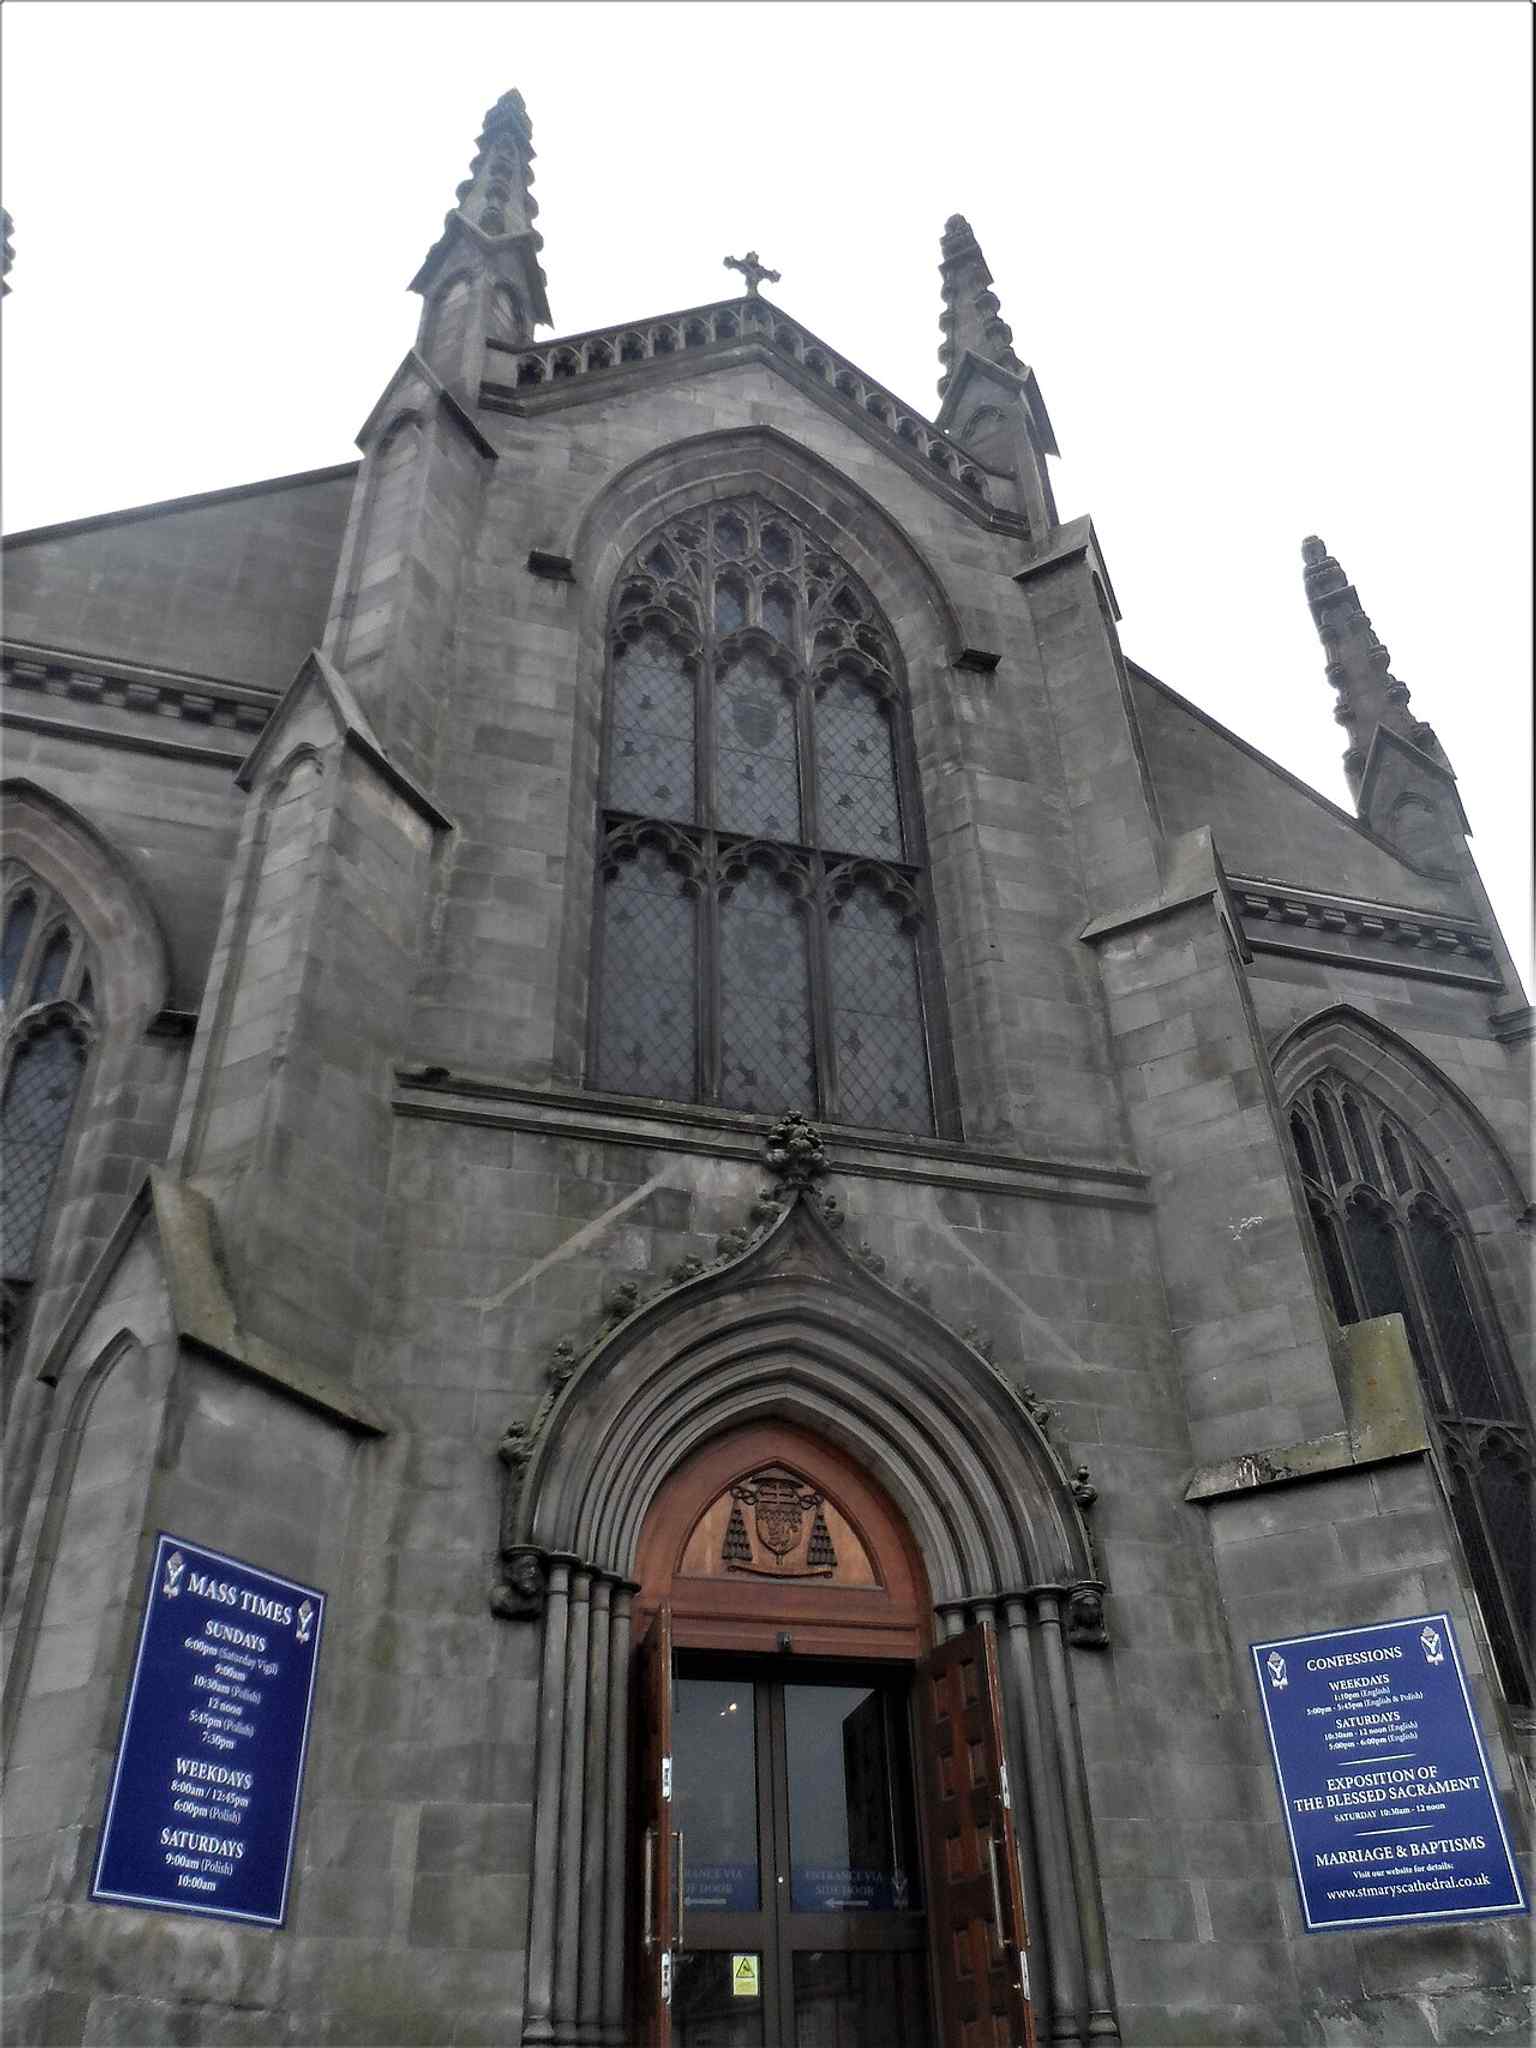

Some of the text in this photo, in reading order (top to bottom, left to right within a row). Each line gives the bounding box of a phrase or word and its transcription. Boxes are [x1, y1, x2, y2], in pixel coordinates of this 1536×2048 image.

[187, 1573, 292, 1625] MASS TIMES
[184, 1637, 217, 1656] 6:00pm
[205, 1620, 265, 1652] SUNDAYS
[1306, 1646, 1402, 1671] CONFESSIONS
[193, 1674, 230, 1694] 10:30am
[1328, 1673, 1390, 1691] WEEKDAYS
[208, 1697, 243, 1716] 12 noon
[189, 1710, 222, 1728] 5:45pm
[1335, 1711, 1401, 1729] SATURDAYS
[202, 1731, 235, 1750] 7:30pm
[176, 1757, 253, 1790] WEEKDAYS
[1327, 1765, 1438, 1791] EXPOSITION OF
[171, 1779, 204, 1797] 8:00am
[212, 1788, 249, 1808] 12:45pm
[1293, 1776, 1480, 1812] THE BLESSED SACRAMENT
[174, 1799, 241, 1825] 6:00pm (Polish)
[1334, 1809, 1377, 1823] SATURDAY
[160, 1827, 244, 1859] SATURDAYS
[1315, 1835, 1485, 1867] MARRIAGE & BAPTISMS
[165, 1853, 233, 1876] 9:00am (Polish)
[1352, 1861, 1454, 1879] Visit our website for details:
[177, 1874, 216, 1891] 10:00am
[1327, 1873, 1490, 1900] www.stmaryscathedral.co.uk
